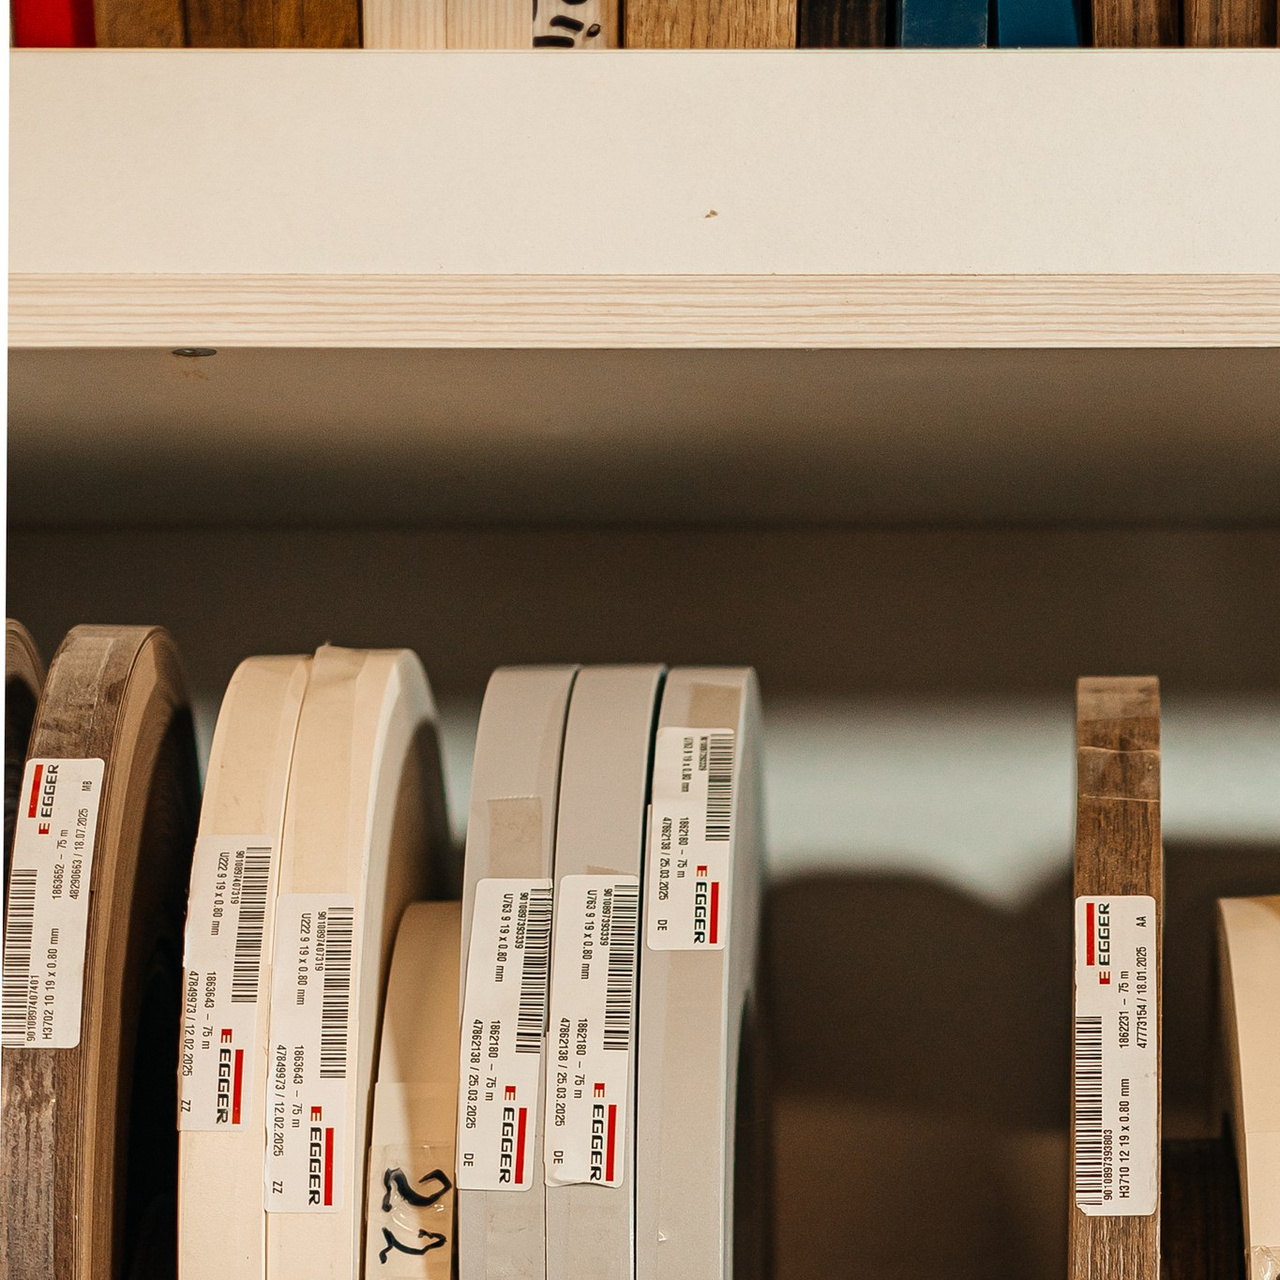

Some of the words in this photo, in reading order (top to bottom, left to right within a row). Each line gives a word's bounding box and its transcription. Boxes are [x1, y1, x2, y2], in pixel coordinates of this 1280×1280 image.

[39, 764, 59, 818] EGGER
[81, 780, 92, 792] MB
[38, 823, 50, 835] E
[60, 829, 68, 837] m
[73, 808, 89, 850] 18.07.2025
[56, 839, 68, 849] 75
[218, 852, 230, 871] U222
[69, 859, 82, 900] 48290663
[696, 865, 708, 877] E
[51, 863, 65, 900] 1863652
[216, 881, 226, 890] 19
[212, 900, 225, 918] 0.80
[501, 893, 514, 914] U763
[586, 890, 597, 910] U763
[693, 882, 708, 944] EGGER
[1136, 916, 1147, 928] AA
[210, 920, 220, 936] mm
[300, 913, 312, 934] U222
[500, 924, 510, 934] 19
[584, 920, 595, 931] 19
[49, 928, 60, 944] mm
[1099, 903, 1110, 966] EGGER
[46, 948, 58, 968] 0.80
[299, 945, 310, 955] 19
[496, 944, 509, 963] 0.80
[581, 941, 593, 960] 0.80
[298, 966, 309, 986] 0.80
[495, 965, 506, 982] mm
[580, 963, 590, 980] mm
[1099, 971, 1111, 985] E
[1120, 970, 1129, 979] m
[1136, 946, 1147, 995] 18.01.2025
[45, 980, 56, 991] 19
[186, 970, 199, 1014] 47849973
[203, 971, 217, 1009] 1863643
[1119, 982, 1129, 993] 75
[44, 995, 55, 1006] 10
[296, 989, 305, 1005] mm
[42, 1009, 55, 1040] H3702
[202, 1025, 214, 1038] 75
[1119, 1011, 1129, 1049] 1862231
[1136, 1004, 1147, 1049] 47773154
[202, 1040, 211, 1049] m
[220, 1028, 233, 1043] E
[469, 1019, 483, 1063] 47862138
[488, 1020, 501, 1058] 1862180
[558, 1017, 571, 1061] 47862138
[576, 1018, 588, 1056] 1862180
[182, 1024, 196, 1076] 12.02.2025
[275, 1044, 287, 1090] 47849973
[293, 1044, 305, 1085] 1863643
[216, 1048, 232, 1124] EGGER
[486, 1076, 497, 1088] 75
[574, 1074, 585, 1086] 75
[1121, 1078, 1130, 1096] mm
[485, 1092, 494, 1101] m
[504, 1086, 516, 1101] E
[554, 1072, 568, 1127] 25.03.2025
[573, 1089, 583, 1099] m
[593, 1083, 605, 1098] E
[180, 1100, 191, 1112] ZZ
[292, 1103, 303, 1115] 75
[465, 1074, 480, 1129] 25.03.2025
[310, 1106, 322, 1122] E
[1119, 1101, 1130, 1122] 0.80
[273, 1102, 285, 1157] 12.02.2025
[291, 1119, 301, 1128] m
[499, 1107, 515, 1184] EGGER
[589, 1104, 605, 1181] EGGER
[1119, 1135, 1130, 1147] 19
[463, 1153, 474, 1167] DE
[553, 1151, 564, 1164] DE
[1103, 1129, 1113, 1201] 9010897393803
[1119, 1150, 1130, 1163] 12
[309, 1127, 322, 1206] EGGER
[272, 1181, 283, 1194] ZZ
[1119, 1166, 1130, 1199] H3710
